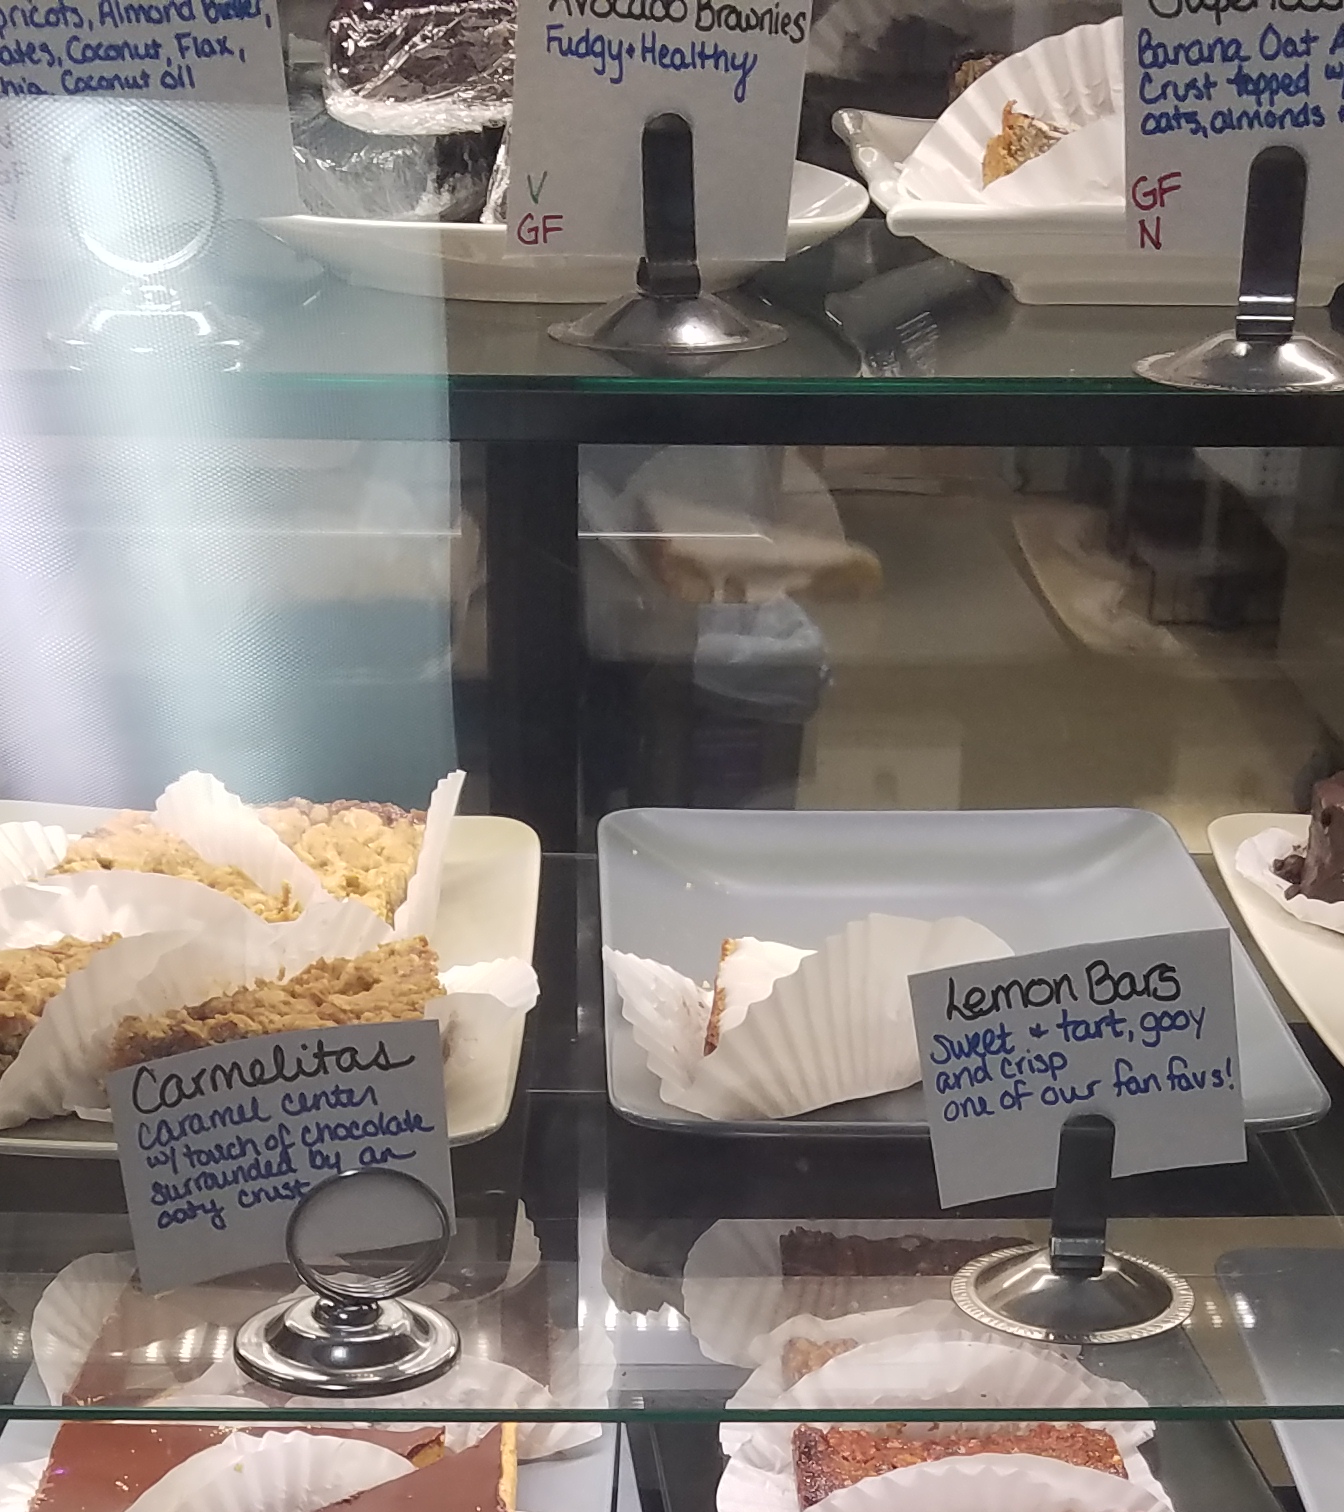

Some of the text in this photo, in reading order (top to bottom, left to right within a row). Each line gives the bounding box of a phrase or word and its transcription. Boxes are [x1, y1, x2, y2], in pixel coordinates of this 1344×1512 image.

[99, 0, 196, 28] Almond
[695, 0, 806, 44] Brownies
[546, 24, 623, 84] Fudgy
[640, 30, 757, 103] Healthy
[1138, 27, 1251, 69] Banana
[1259, 22, 1319, 60] Oat
[61, 68, 150, 95] Coconut
[1226, 62, 1310, 107] topped
[527, 171, 547, 204] V
[1131, 171, 1181, 211] GF
[517, 213, 563, 245] GF
[1139, 216, 1162, 250] N
[946, 960, 1181, 1021] Lemon Bars
[1056, 1008, 1134, 1043] tart,
[1139, 1006, 1206, 1047] gooy
[131, 1039, 416, 1114] Carmelitas
[935, 1048, 1068, 1095] and crisp
[943, 1055, 1235, 1122] one of our fan favs!
[281, 1084, 378, 1117] center
[147, 1147, 178, 1175] w/
[184, 1134, 261, 1170] touch
[264, 1122, 296, 1153] of
[150, 1146, 417, 1206] surrounded by an
[157, 1178, 311, 1230] oaty crust
